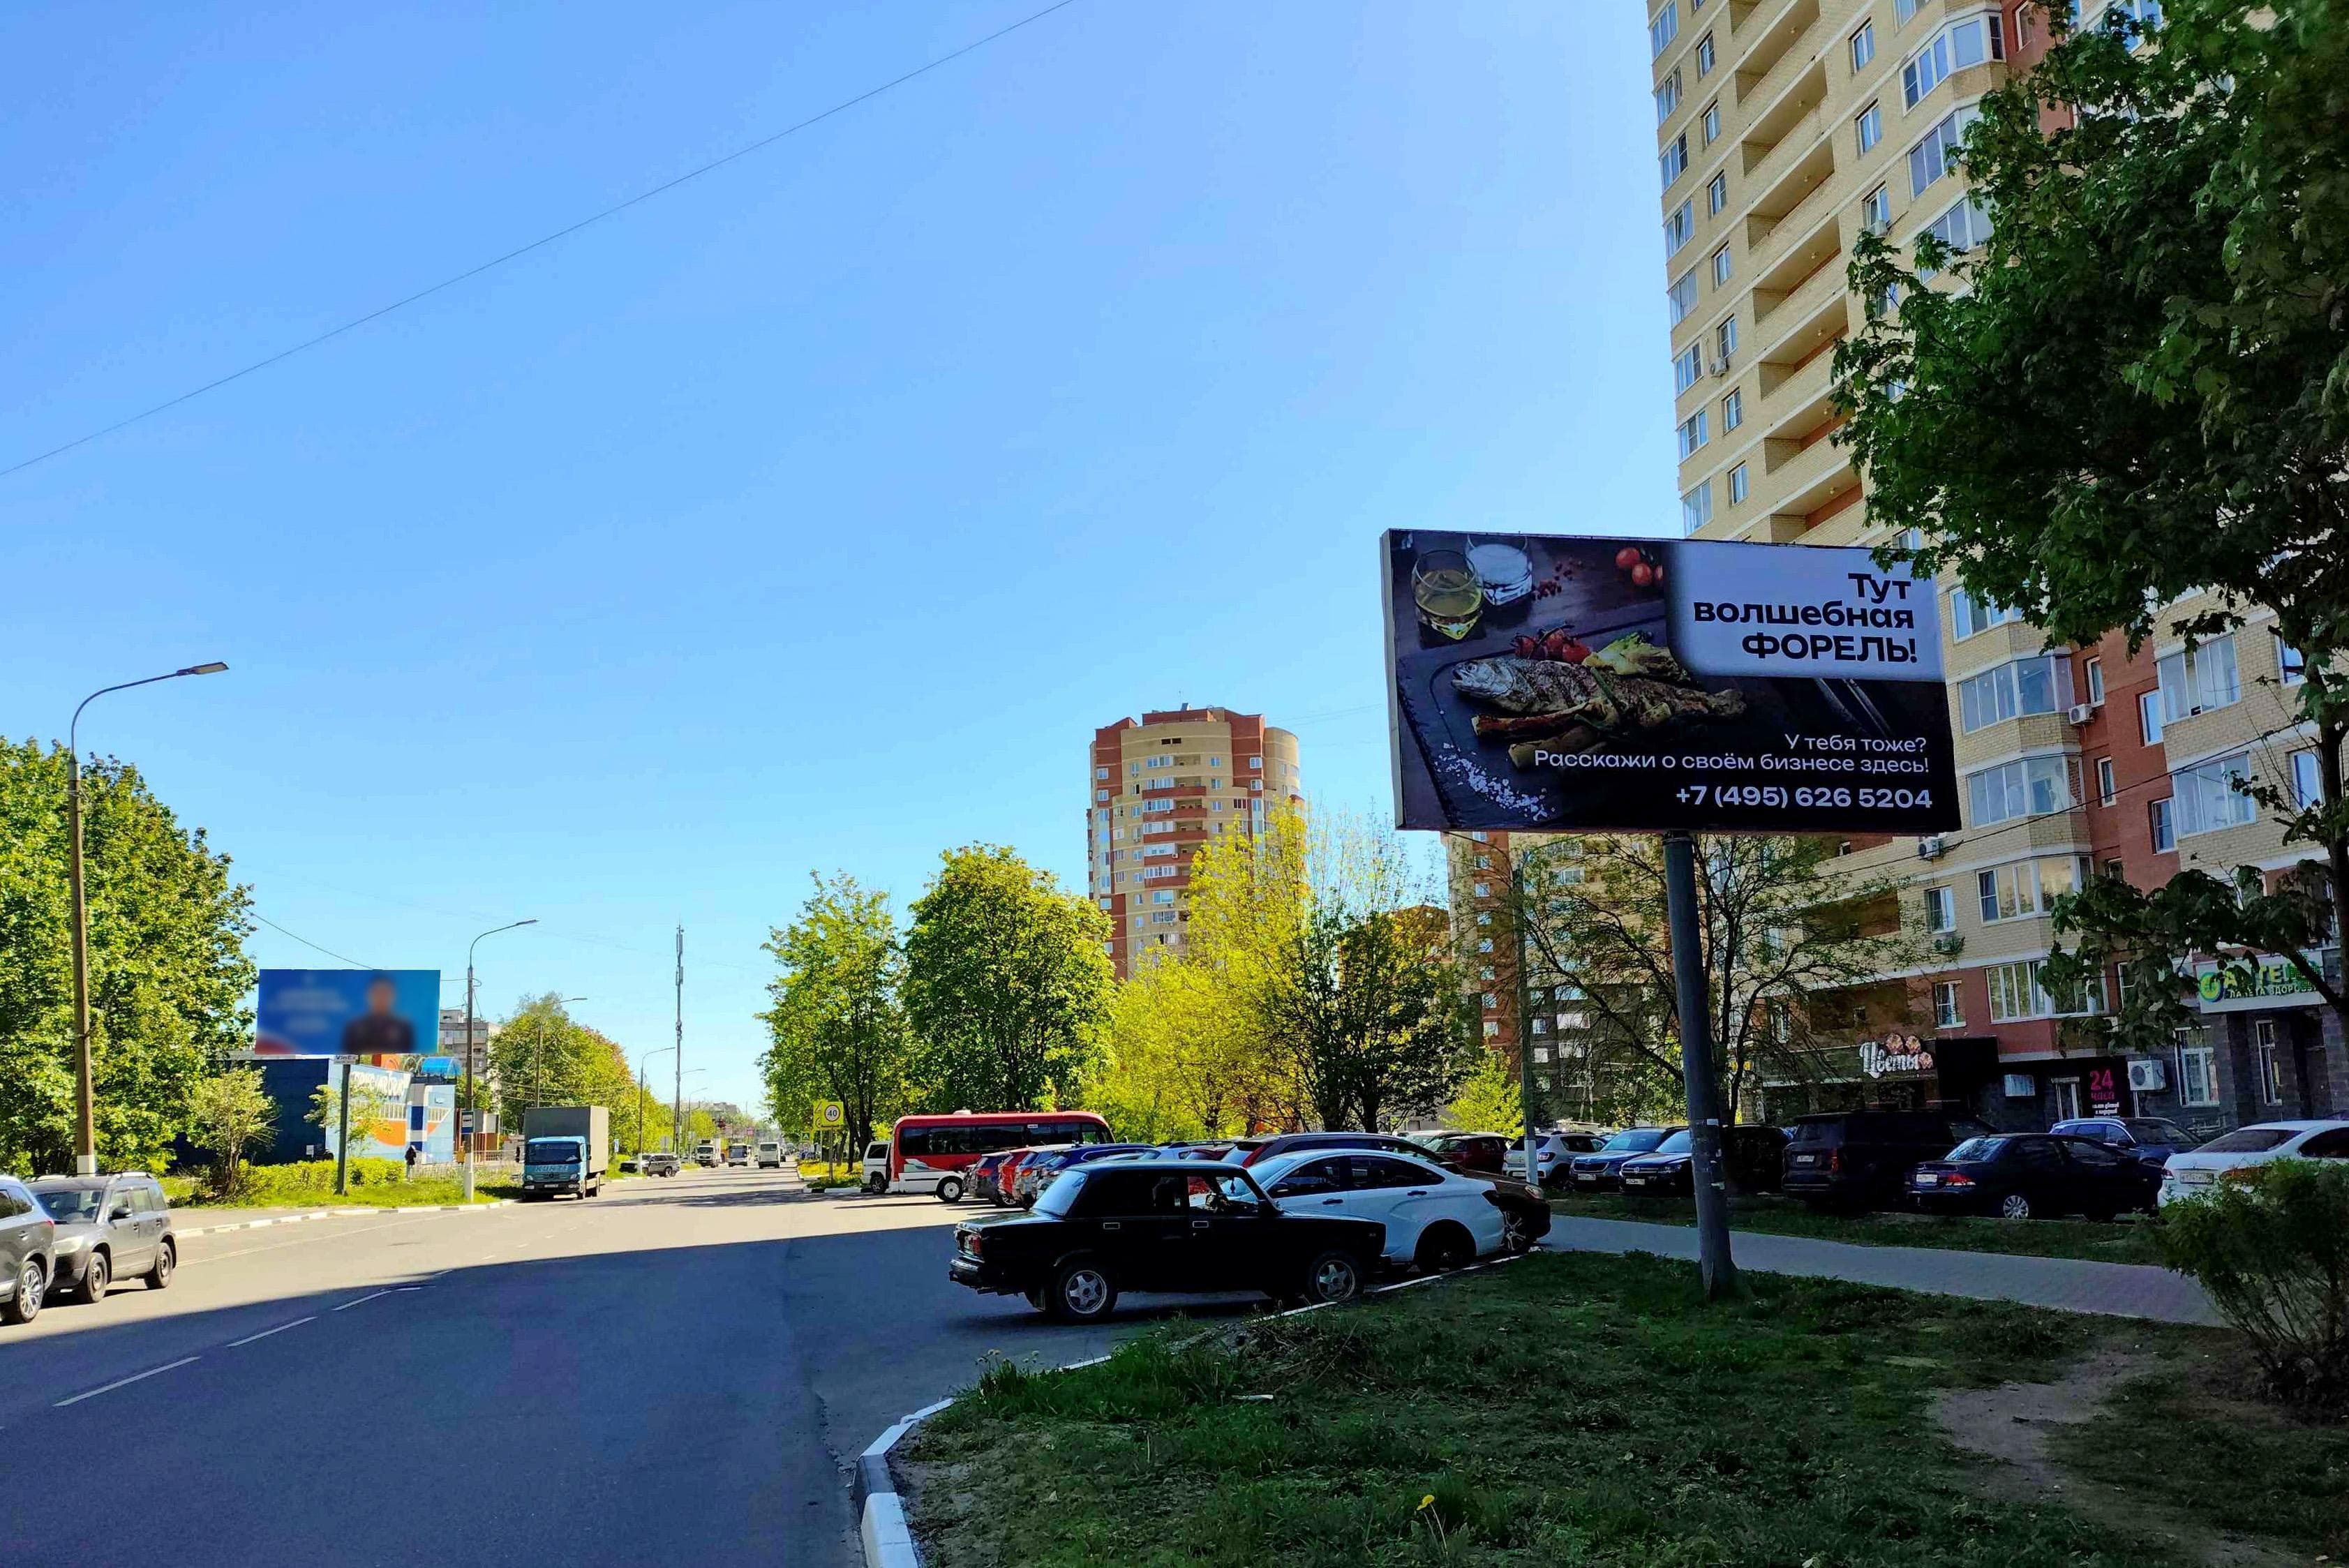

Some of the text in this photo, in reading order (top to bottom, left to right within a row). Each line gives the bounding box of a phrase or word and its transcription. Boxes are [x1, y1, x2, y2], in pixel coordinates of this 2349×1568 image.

[1848, 572, 1911, 604] Тут
[1693, 599, 1915, 629] волшебная
[1742, 632, 1918, 664] ФОРЕЛЬ!
[1784, 733, 1927, 753] У тебя тоже?
[1535, 749, 1930, 775] Расскажи о своём бизнесе здесь!
[1676, 785, 1933, 809] +7 (495) 626 5204
[1859, 1041, 1920, 1079] Цветы
[2089, 1068, 2114, 1091] 24
